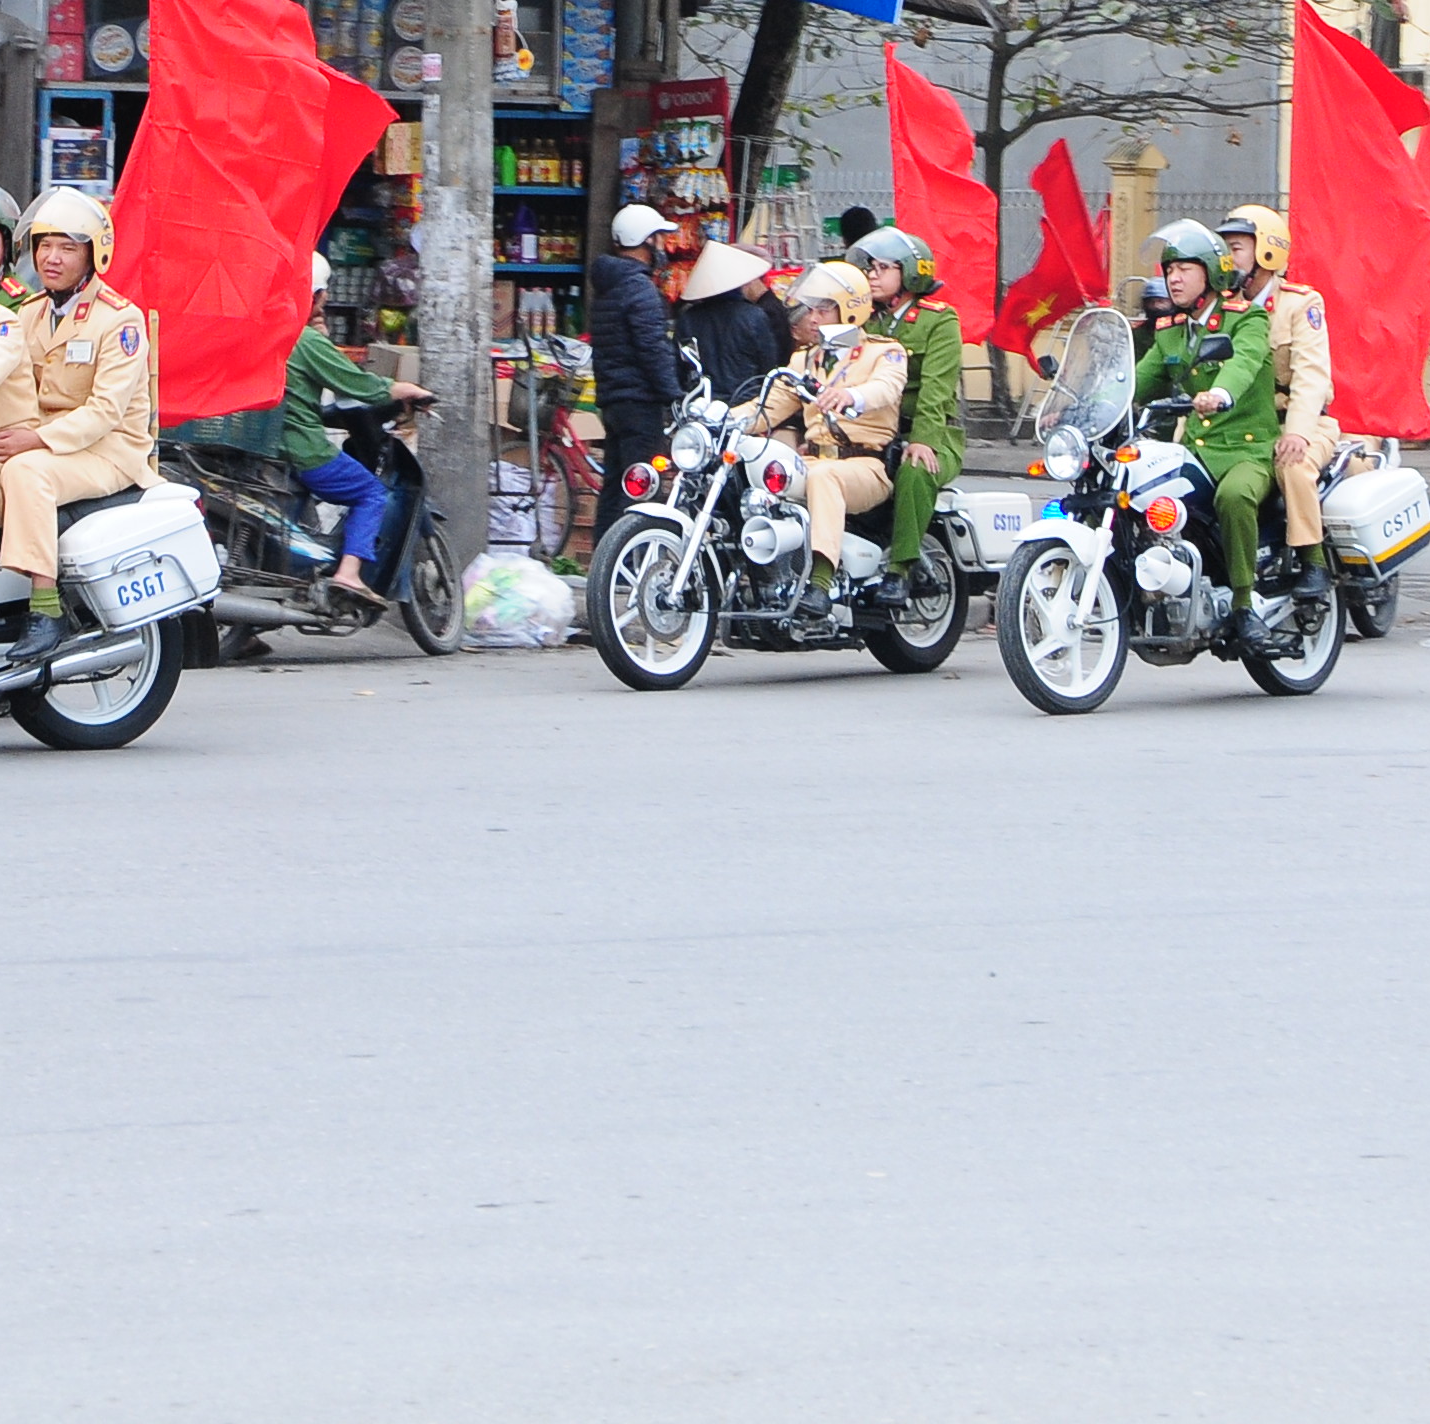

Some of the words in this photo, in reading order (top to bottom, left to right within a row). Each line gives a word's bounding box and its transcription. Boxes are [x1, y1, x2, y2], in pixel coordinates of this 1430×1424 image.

[994, 514, 1021, 531] CS113
[1383, 501, 1421, 538] CSTT
[117, 572, 165, 606] CSGT
